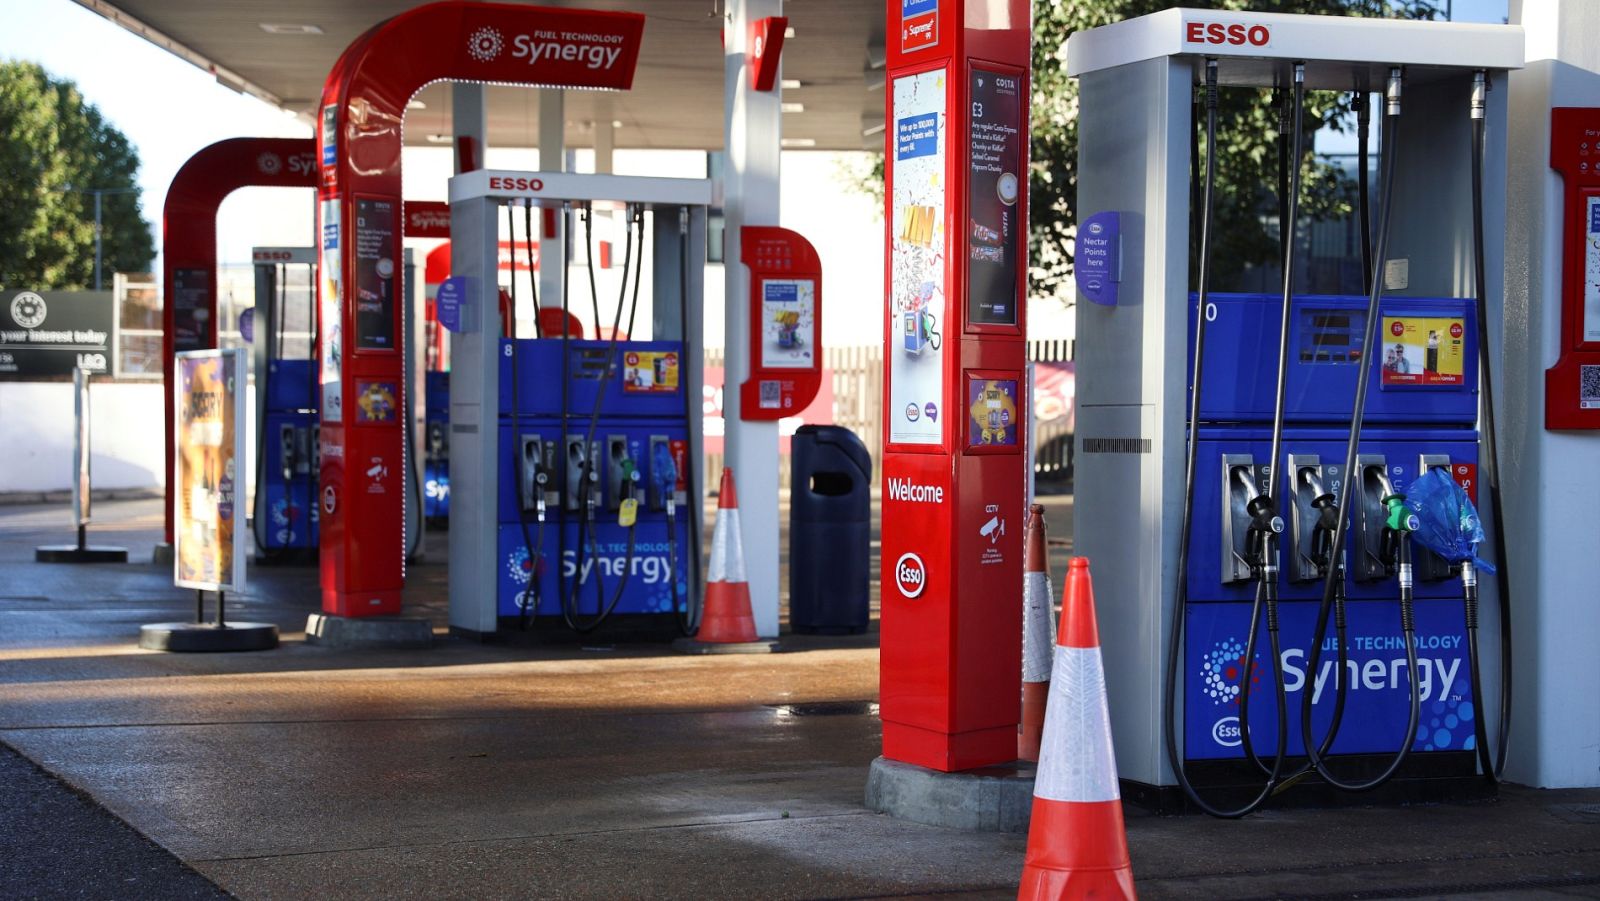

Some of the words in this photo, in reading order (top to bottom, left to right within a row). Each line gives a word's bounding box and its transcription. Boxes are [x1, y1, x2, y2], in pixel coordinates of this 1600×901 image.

[534, 30, 558, 40] FUEL
[560, 32, 624, 44] TECHNOLOGY
[1186, 22, 1270, 46] ESSO
[512, 34, 622, 69] Synergy
[755, 36, 762, 58] 8
[996, 78, 1014, 89] COSTA
[972, 101, 983, 117] £3
[972, 121, 980, 131] Any
[489, 177, 544, 191] ESSO
[1084, 237, 1107, 246] Nectar
[254, 251, 291, 261] ESSO
[1084, 247, 1107, 256] Points
[1087, 258, 1103, 266] here
[28, 329, 73, 343] interest
[74, 329, 107, 345] today
[504, 344, 513, 356] 8
[888, 477, 944, 503] Welcome
[986, 504, 999, 513] CCTV
[563, 550, 678, 585] Synergy
[900, 563, 921, 584] Esso
[1280, 648, 1461, 704] Synergy
